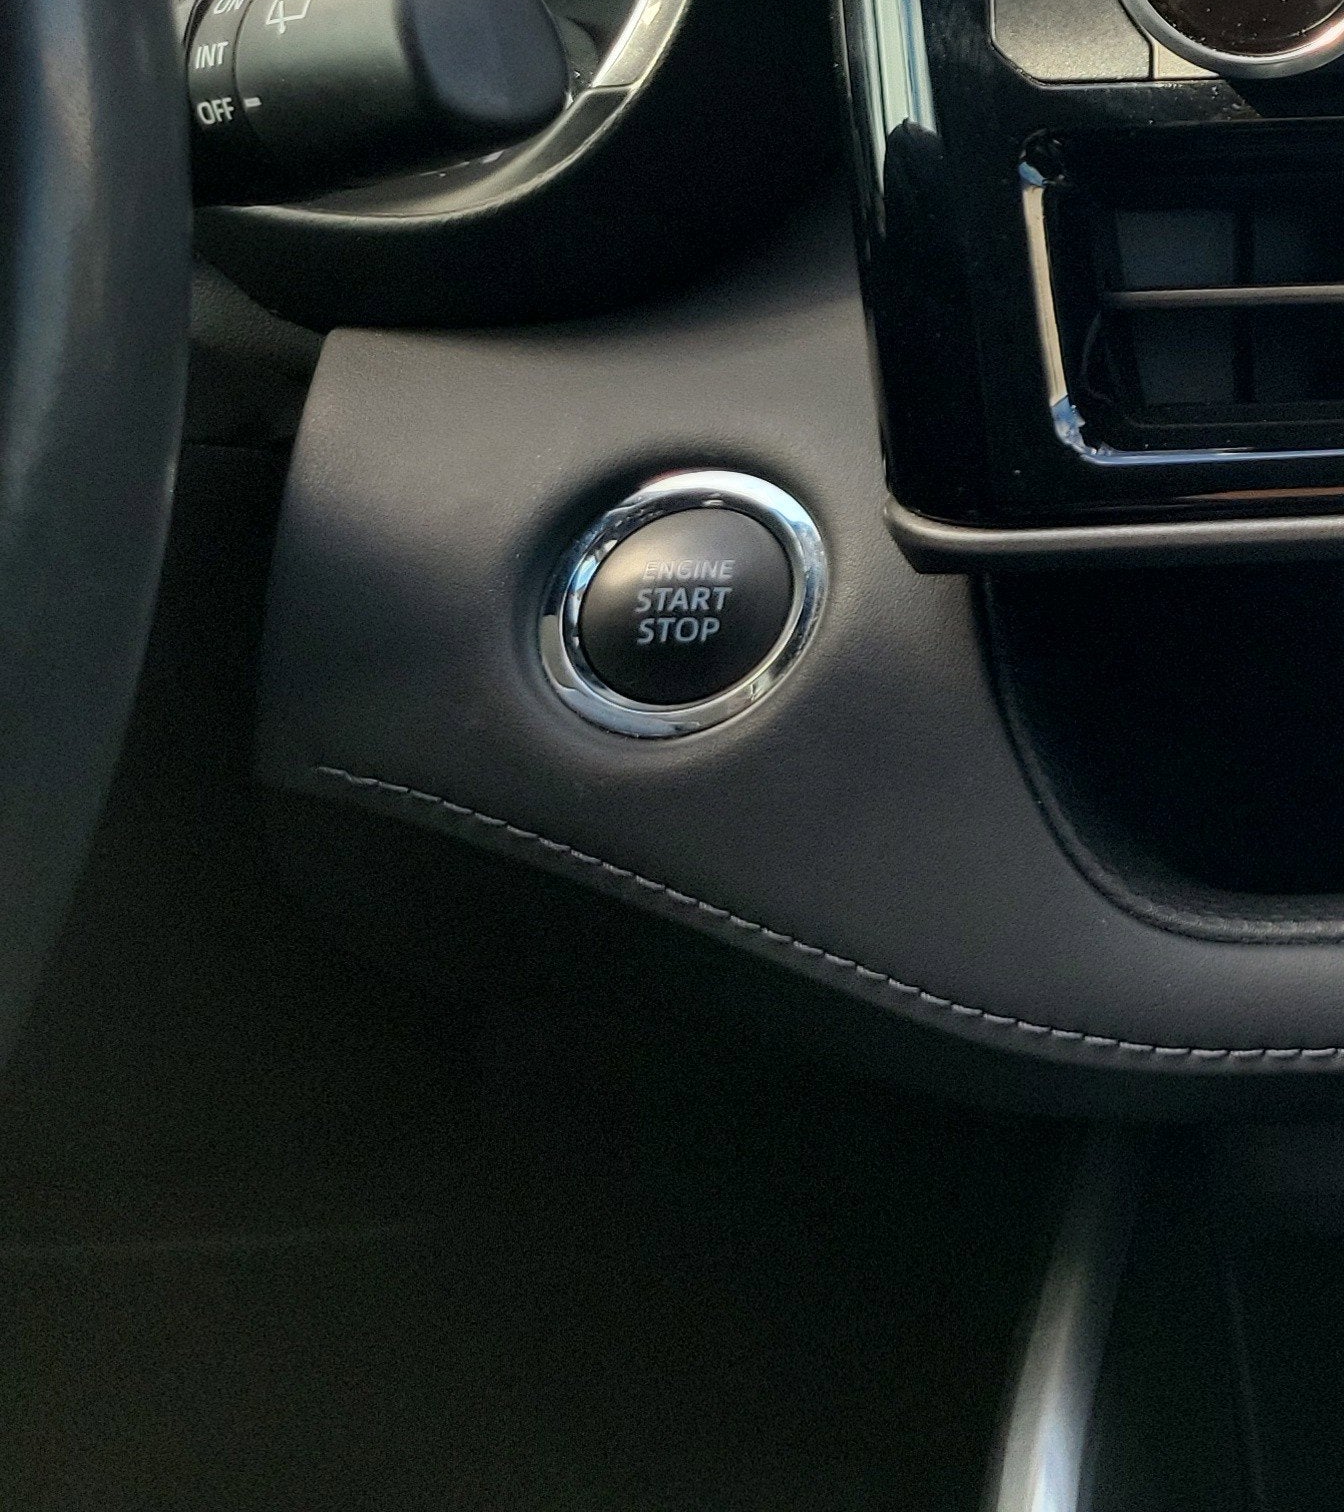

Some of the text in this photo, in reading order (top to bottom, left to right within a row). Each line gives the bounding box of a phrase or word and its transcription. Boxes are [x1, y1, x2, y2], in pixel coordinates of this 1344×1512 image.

[194, 41, 229, 70] INT
[196, 97, 235, 126] OFF
[642, 558, 736, 581] ENGINE
[634, 587, 734, 614] START
[636, 617, 721, 645] STOP
